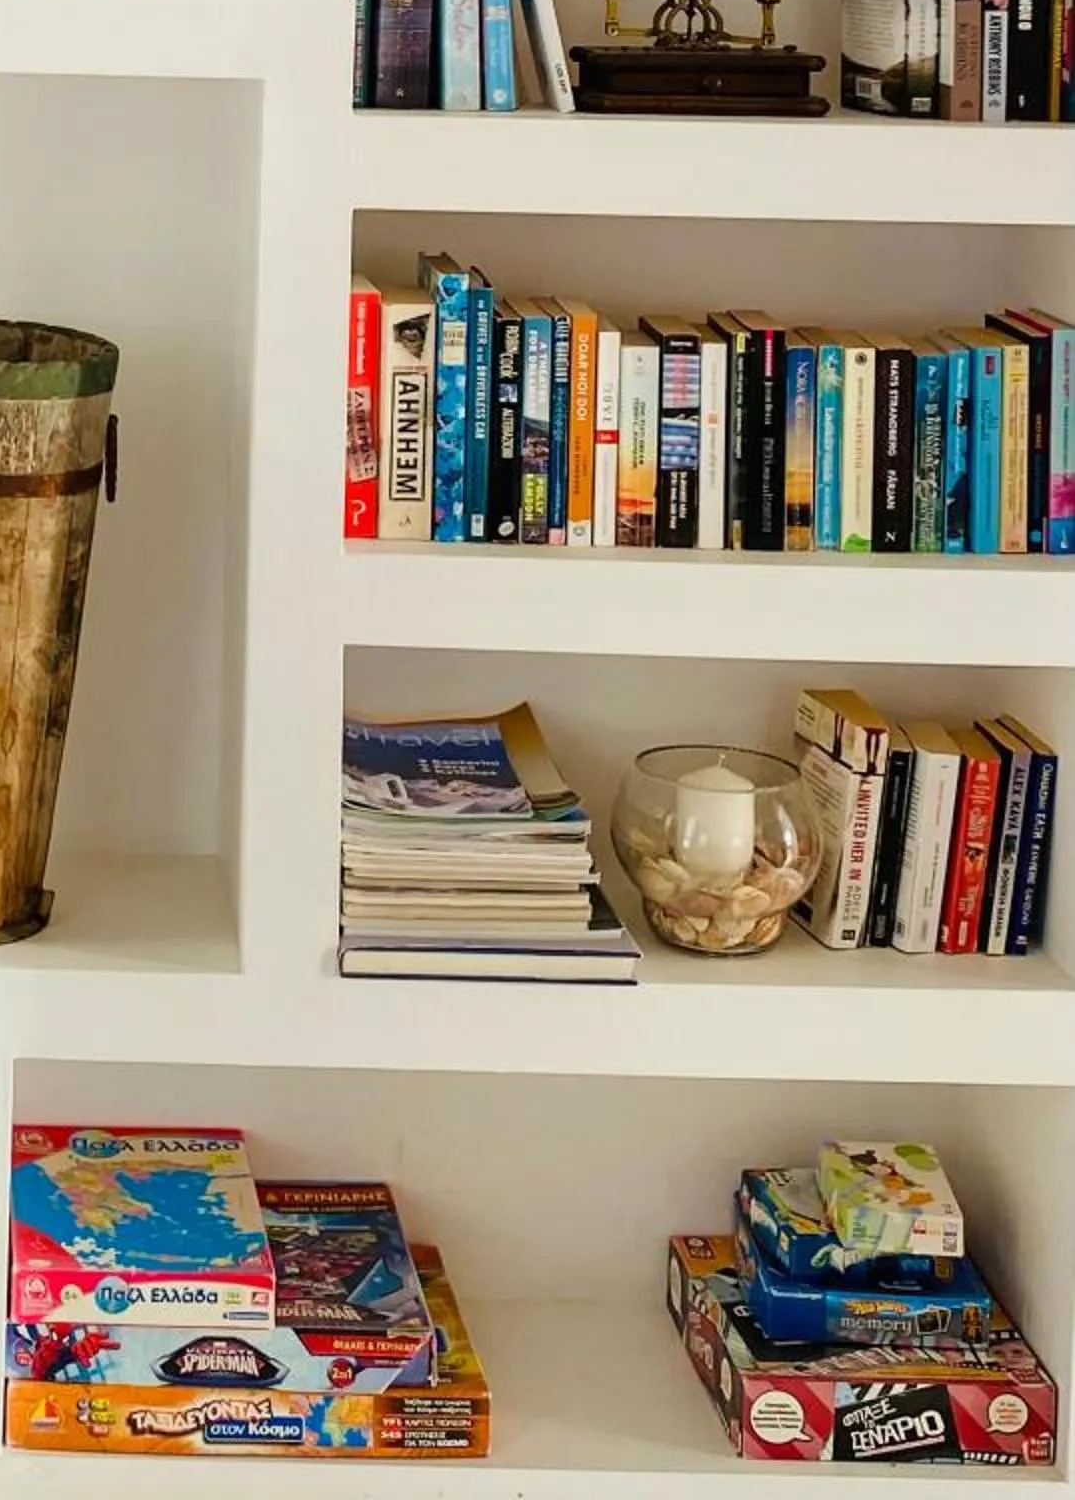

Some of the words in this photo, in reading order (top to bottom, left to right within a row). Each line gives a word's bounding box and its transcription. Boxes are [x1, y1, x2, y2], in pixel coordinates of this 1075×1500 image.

[988, 14, 1004, 55] ANTHONY
[477, 311, 488, 345] DRIVER
[505, 325, 520, 354] ROBIN
[528, 329, 538, 353] FOR
[499, 352, 517, 379] COOK
[577, 334, 589, 369] DOAR
[576, 371, 588, 396] NOI
[888, 359, 899, 387] MATS
[475, 365, 487, 419] DRIVERLESS
[576, 397, 588, 421] DOI
[886, 388, 899, 457] STRANDBERG
[474, 421, 486, 439] CAR
[1011, 767, 1027, 797] ALEX
[852, 788, 871, 839] INVITED
[1005, 800, 1022, 831] KAVA
[850, 841, 865, 864] HER
[848, 868, 861, 881] IN
[72, 1137, 134, 1153] Παζλ
[142, 1138, 241, 1153] Ελλάδα
[100, 1286, 146, 1305] Παζλ
[150, 1286, 218, 1304] Ελλάδα
[839, 1317, 913, 1337] memory
[131, 1398, 273, 1432] ΤΑΞΙΔΕΥΟΝΤΑΣ
[210, 1425, 244, 1436] στον
[247, 1421, 300, 1438] Κόσμο
[850, 1409, 945, 1451] ΣΕΝΑΡΙΟ
